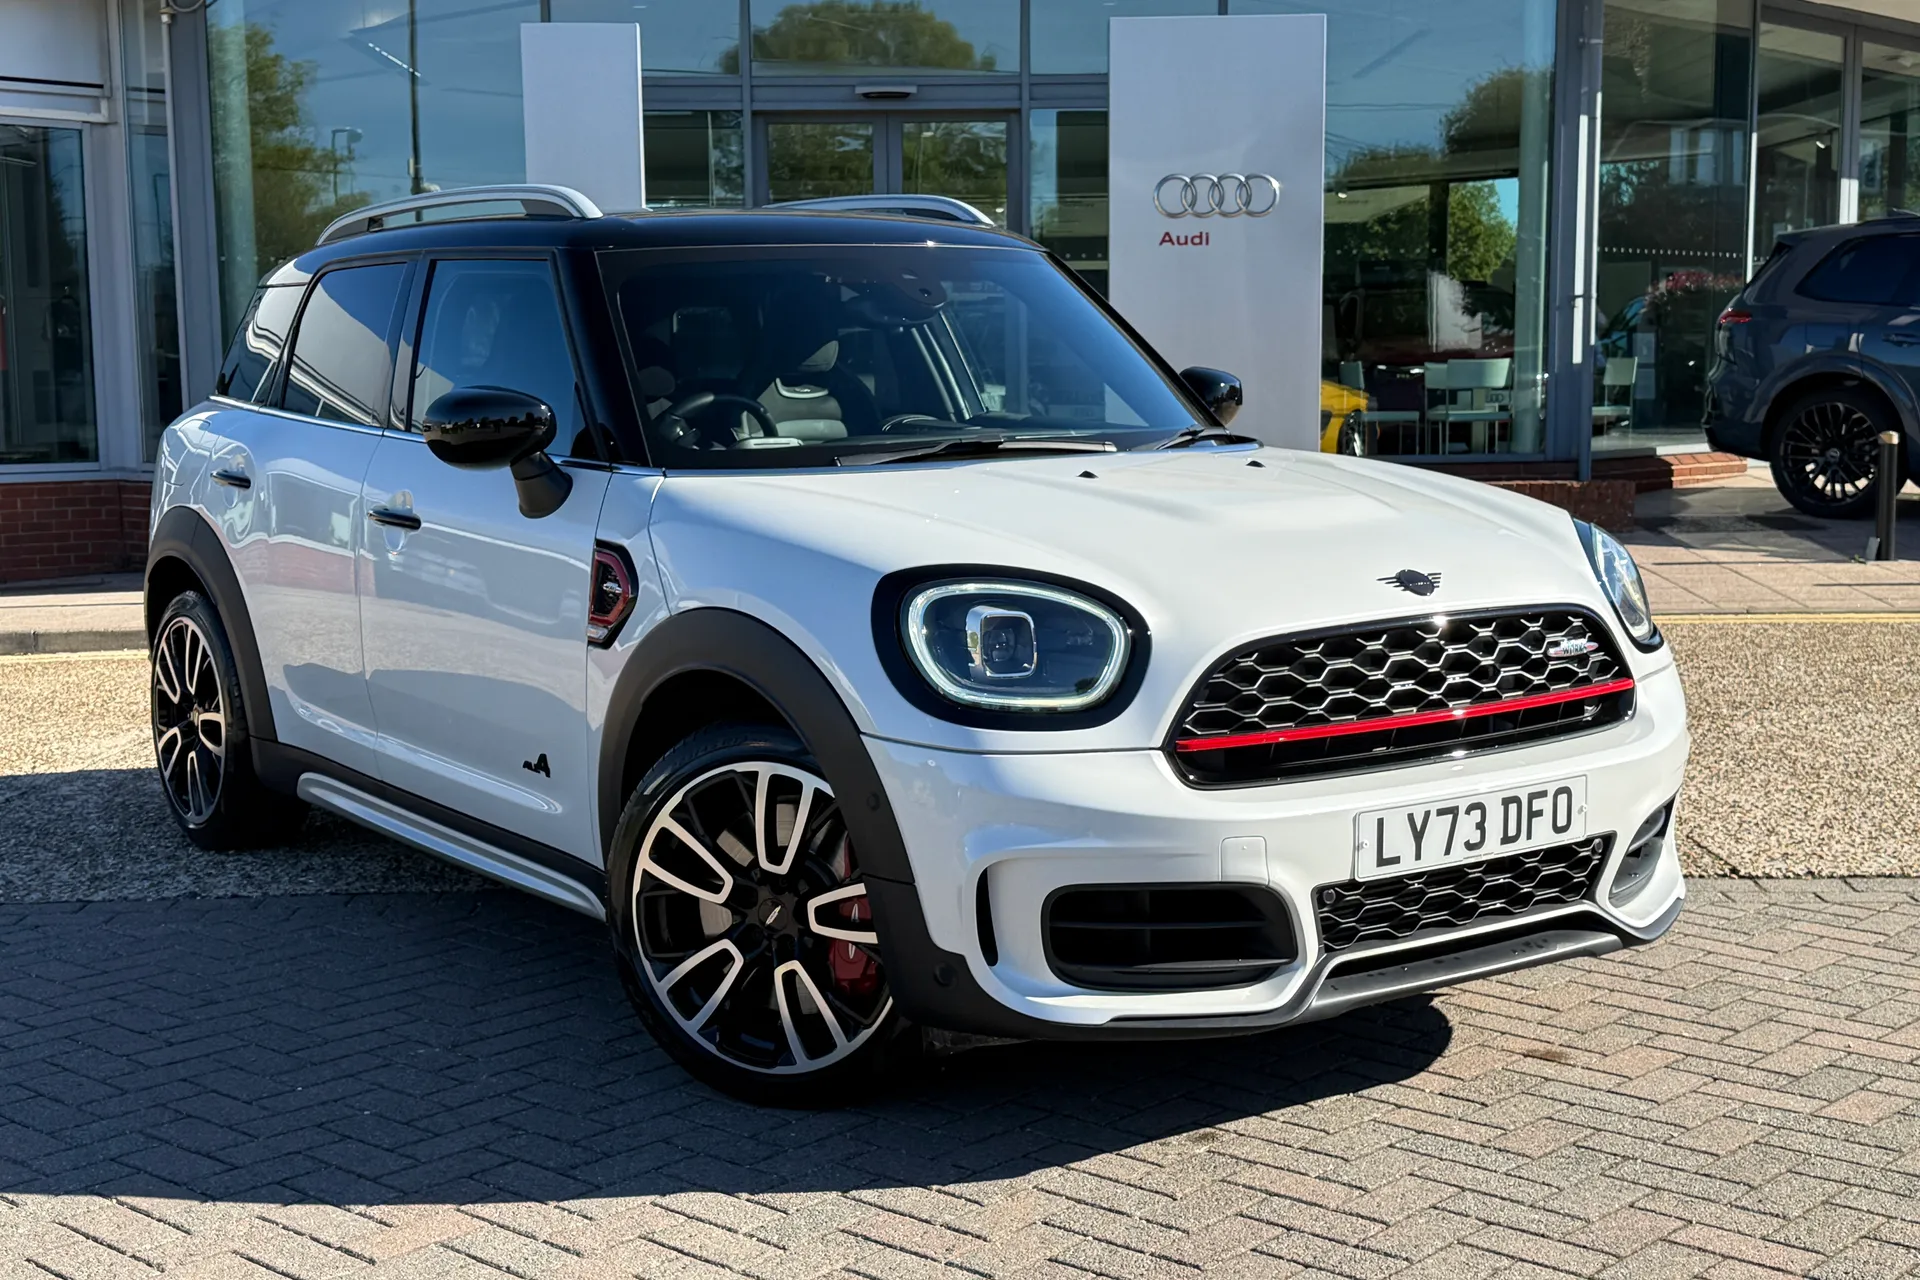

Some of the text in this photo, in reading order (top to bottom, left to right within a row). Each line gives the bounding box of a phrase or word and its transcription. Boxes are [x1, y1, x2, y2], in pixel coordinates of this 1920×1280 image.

[1159, 231, 1210, 246] Audi
[1376, 785, 1573, 868] LY73 DFO
